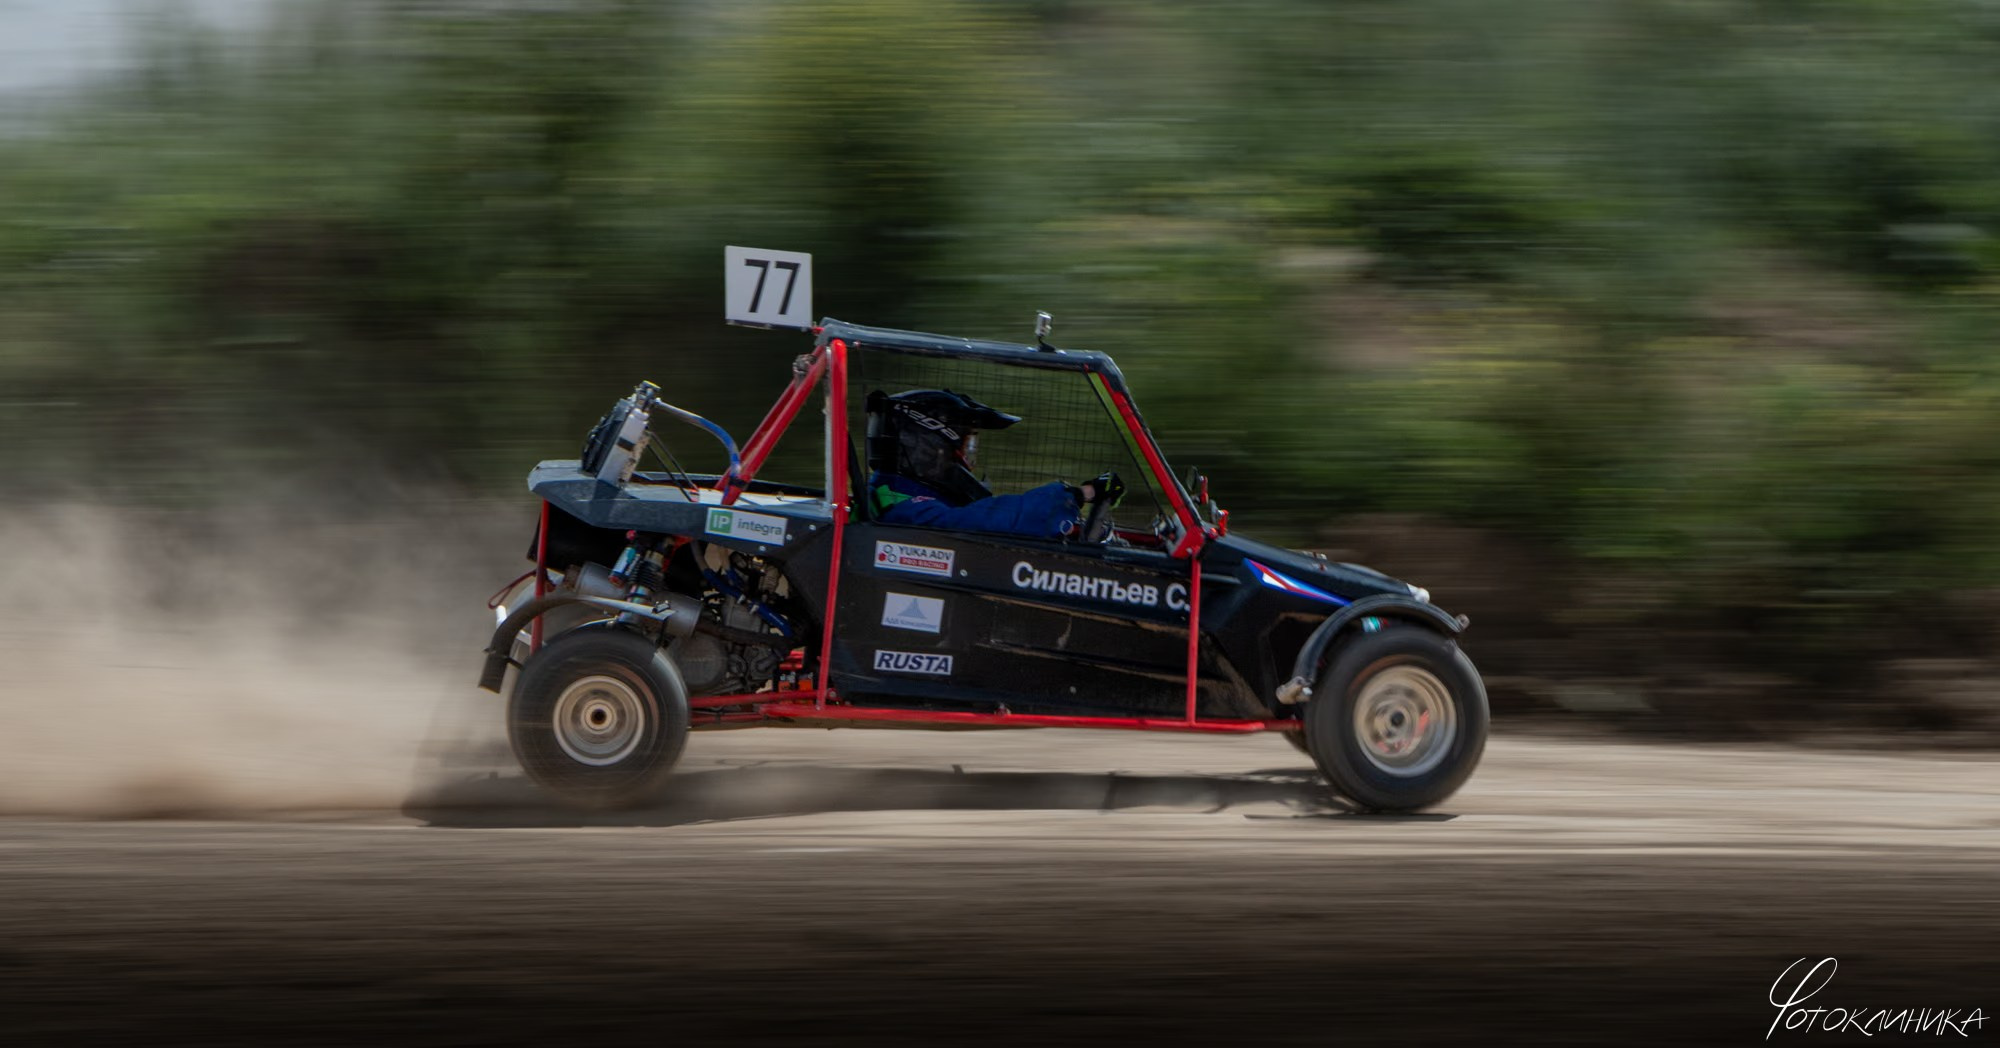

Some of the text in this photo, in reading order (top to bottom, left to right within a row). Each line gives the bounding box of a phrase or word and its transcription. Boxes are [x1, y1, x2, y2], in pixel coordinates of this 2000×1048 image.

[743, 258, 802, 316] 77
[713, 514, 783, 536] IP integra
[898, 545, 952, 561] YUKA ADV
[1011, 561, 1191, 613] Силантьев С.
[877, 652, 949, 673] RUSTA
